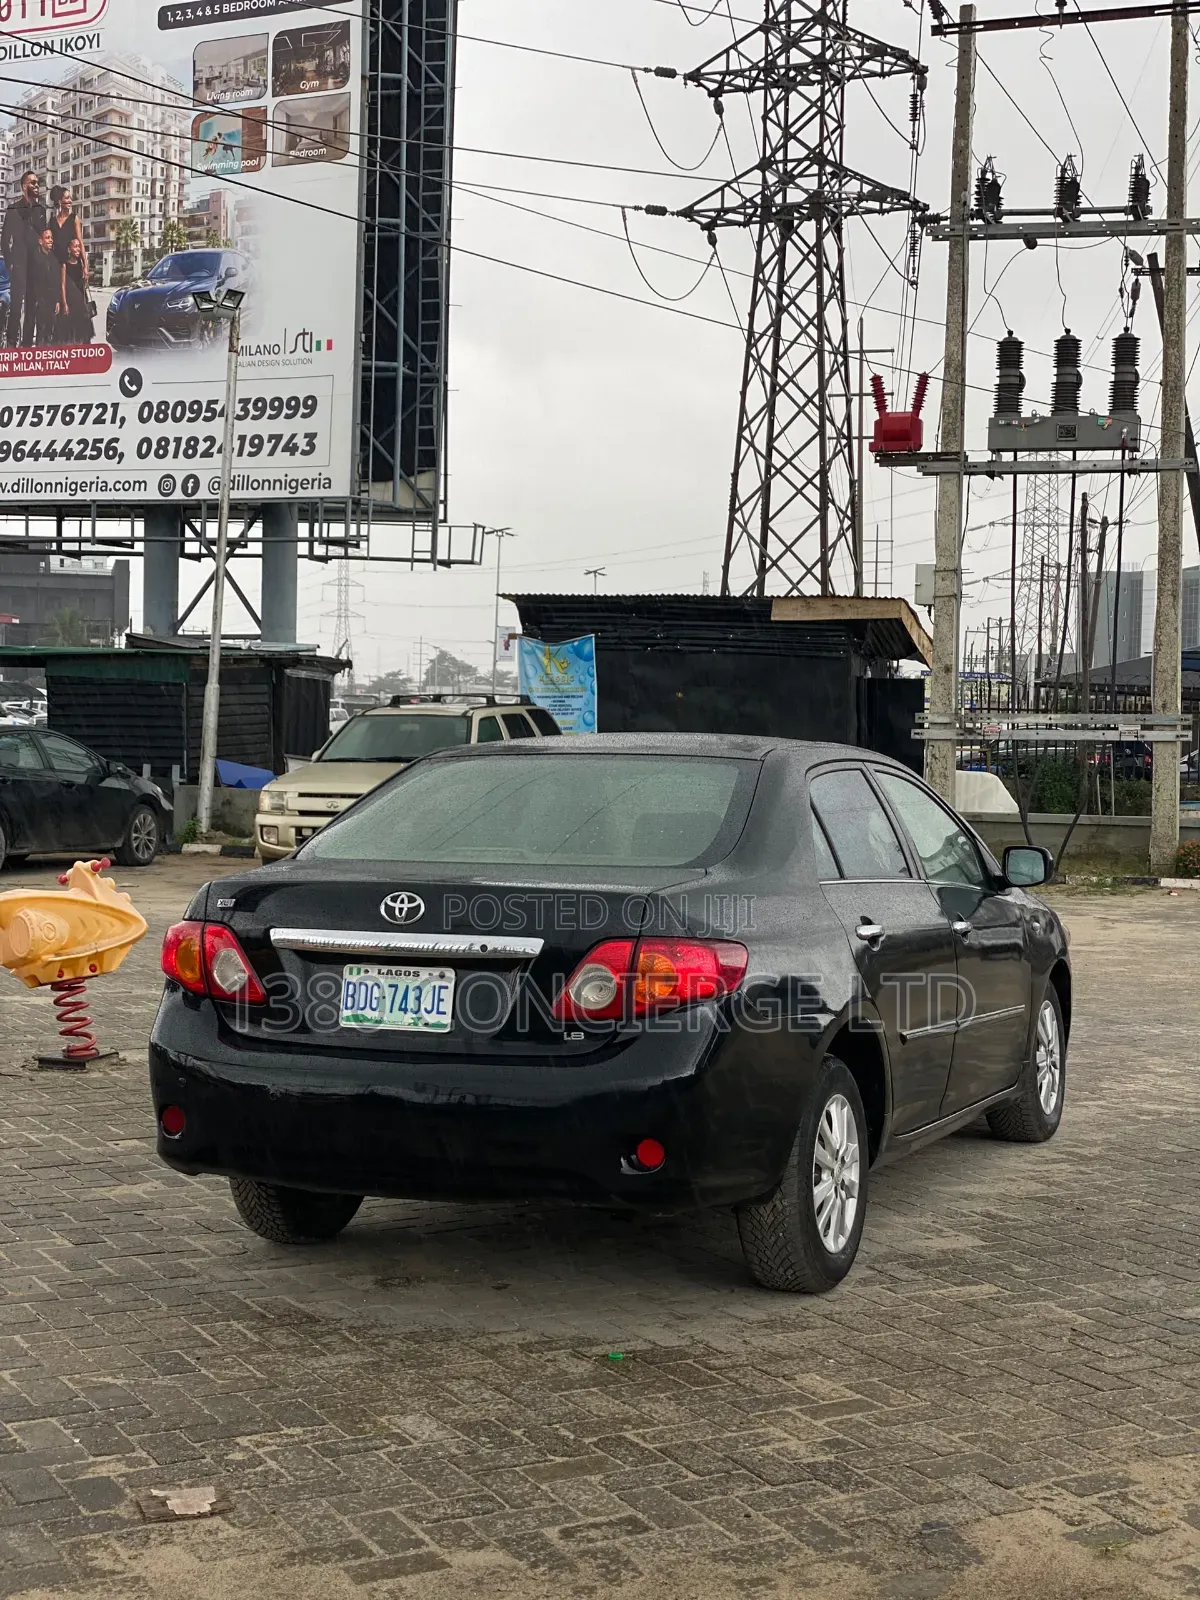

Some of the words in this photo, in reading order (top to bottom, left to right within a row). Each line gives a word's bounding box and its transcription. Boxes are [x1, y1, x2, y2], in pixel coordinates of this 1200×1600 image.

[167, 11, 174, 22] 1,
[176, 10, 184, 21] 2,
[186, 9, 194, 19] 3,
[196, 8, 203, 17] 4
[205, 6, 212, 16] &
[214, 5, 220, 14] 5
[222, 0, 276, 13] BEDROOM
[0, 40, 55, 61] DILLON
[60, 33, 100, 53] IKOYI
[300, 79, 319, 90] Gym
[206, 91, 231, 102] Living
[232, 89, 253, 98] room
[196, 159, 239, 171] Swimming
[240, 157, 259, 170] pool
[0, 352, 18, 361] TRIP
[21, 351, 33, 360] TO
[35, 349, 69, 359] DESIGN
[71, 347, 105, 358] STUDIO
[0, 363, 9, 371] IN
[13, 361, 44, 372] MILAN,
[46, 360, 71, 370] ITALY
[257, 359, 280, 367] DESIGN
[281, 358, 313, 366] SOLUTION
[0, 402, 126, 429] 07576721,
[377, 968, 420, 978] LAGOS
